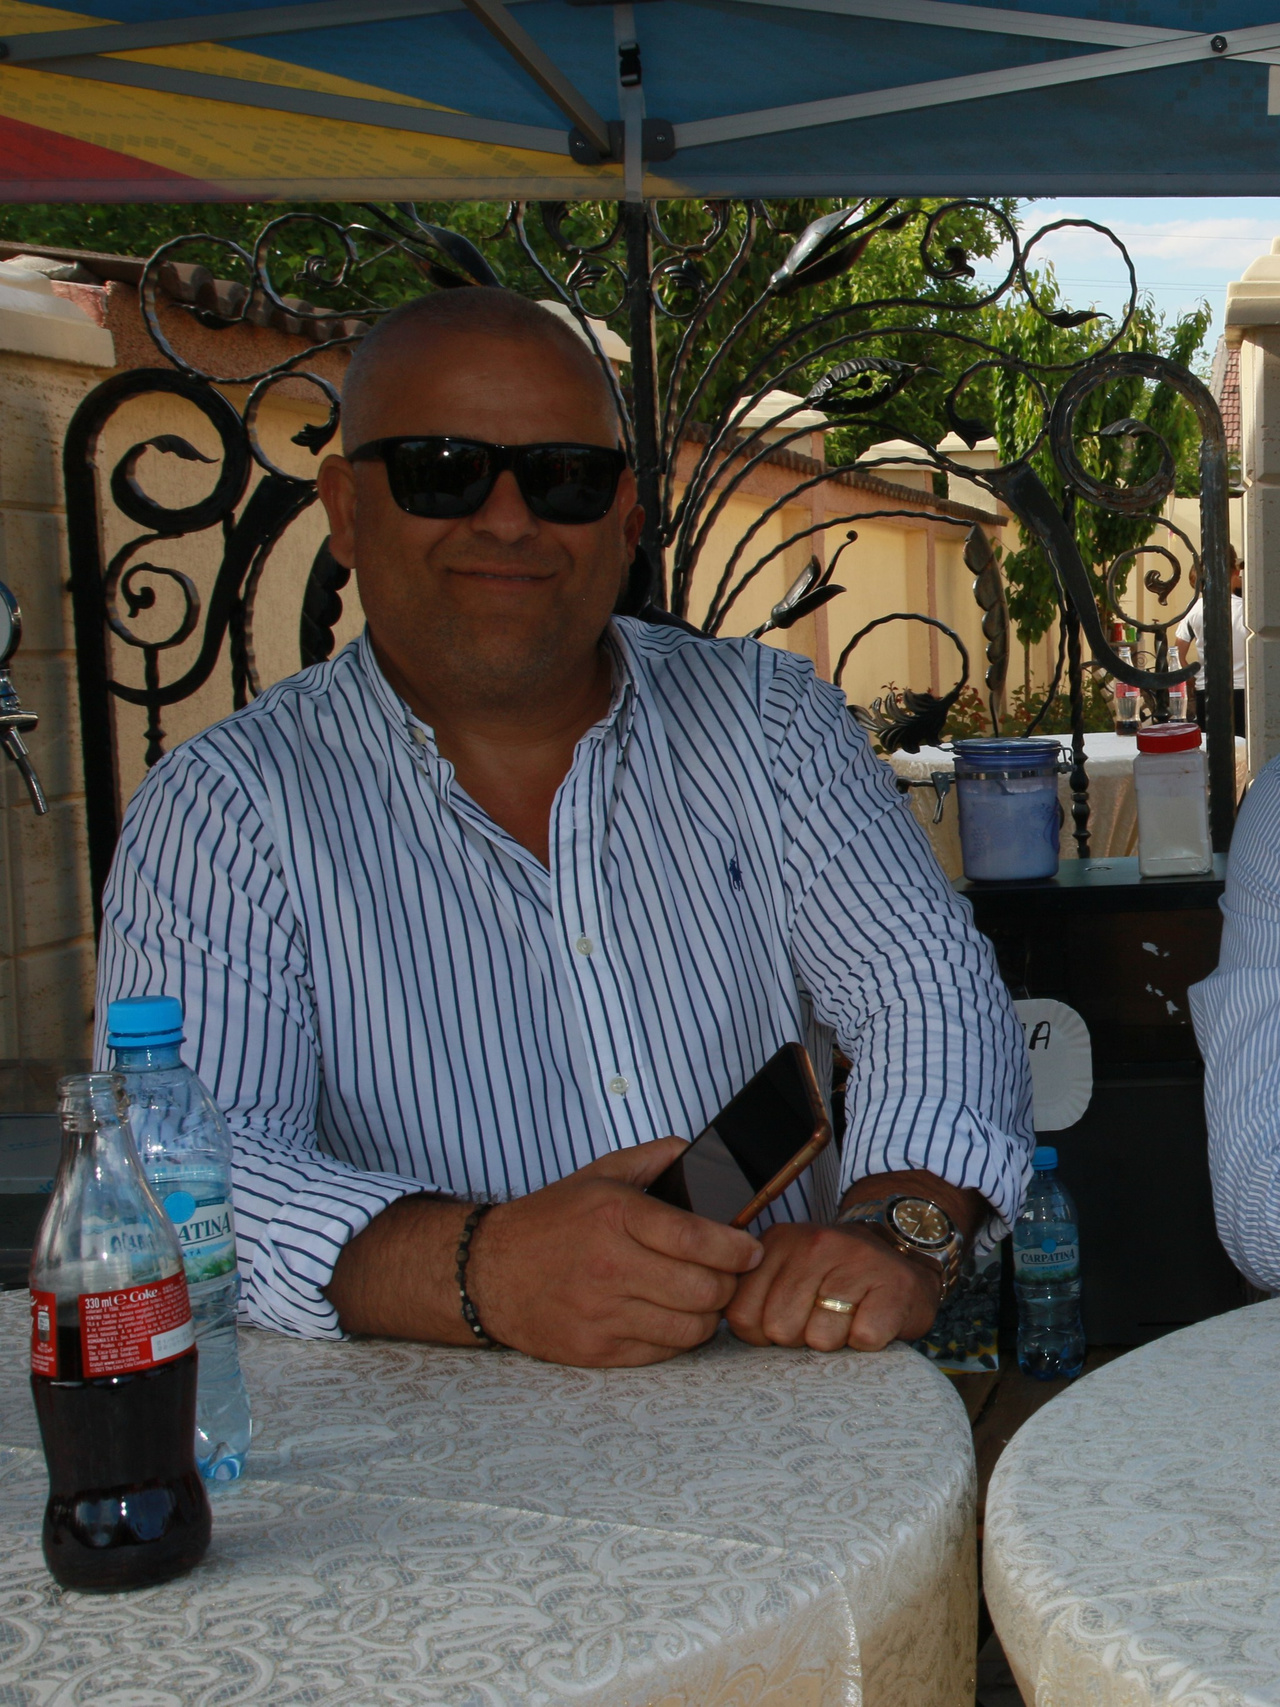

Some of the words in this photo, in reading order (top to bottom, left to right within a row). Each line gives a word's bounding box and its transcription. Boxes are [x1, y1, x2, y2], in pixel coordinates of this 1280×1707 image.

[1021, 1021, 1051, 1050] A
[179, 1211, 231, 1241] ATINA
[1021, 1249, 1075, 1263] CARPATINA
[85, 1297, 100, 1309] 330
[101, 1296, 112, 1308] ml
[129, 1289, 158, 1303] Coke
